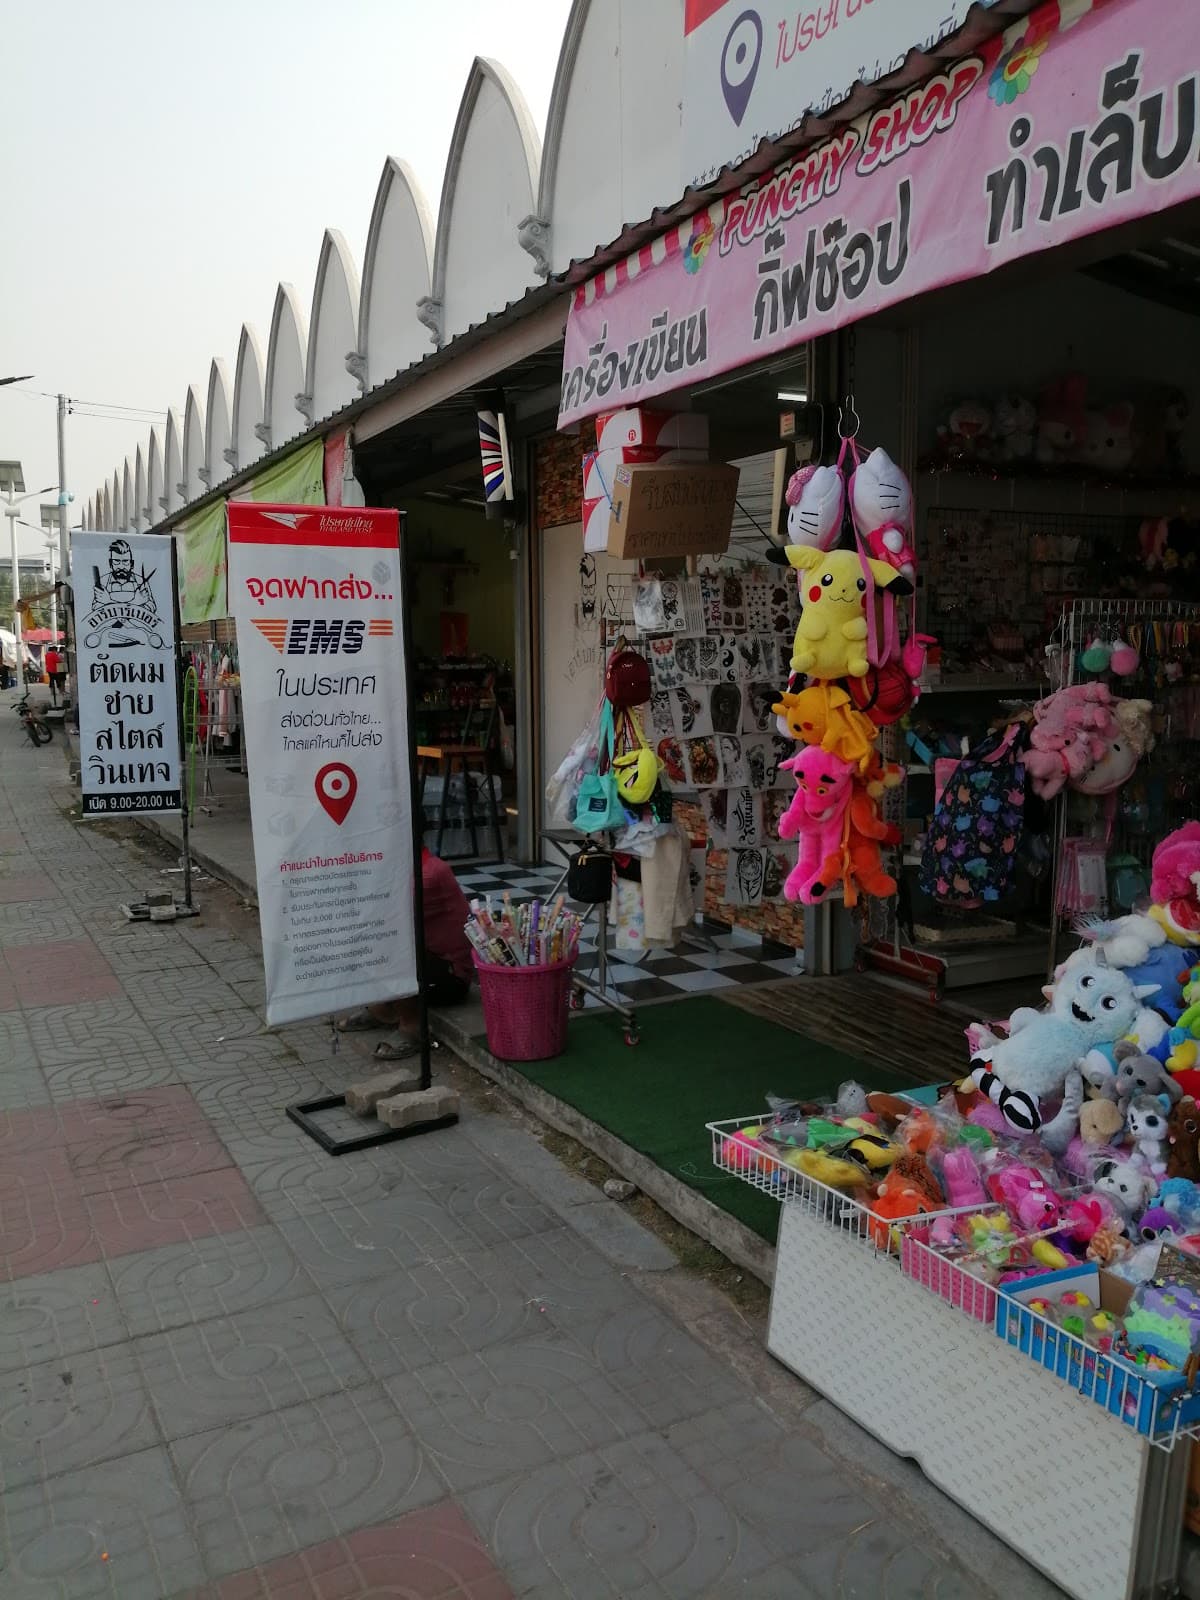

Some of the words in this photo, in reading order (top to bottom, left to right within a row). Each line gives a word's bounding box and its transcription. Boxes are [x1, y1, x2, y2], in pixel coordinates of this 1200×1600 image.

[719, 131, 858, 255] PUNCHY
[857, 57, 984, 174] SHOP
[560, 309, 708, 413] เครื่องเขียน
[986, 53, 1200, 246] ทำเล็บ
[287, 619, 366, 655] EMS
[89, 653, 165, 684] ตัดผม
[276, 668, 377, 697] ในประเทศ
[104, 691, 154, 715] ชาย
[95, 720, 166, 751] สไตล์
[282, 729, 383, 752] ไกลแค่ไหนก็ไปส่ง
[88, 755, 171, 785] วินเทจ
[88, 796, 107, 810] เปิด
[109, 795, 163, 809] 9.00-20.00
[165, 794, 176, 806] น.
[279, 852, 384, 872] คำแนะนำในการใช้บริการ
